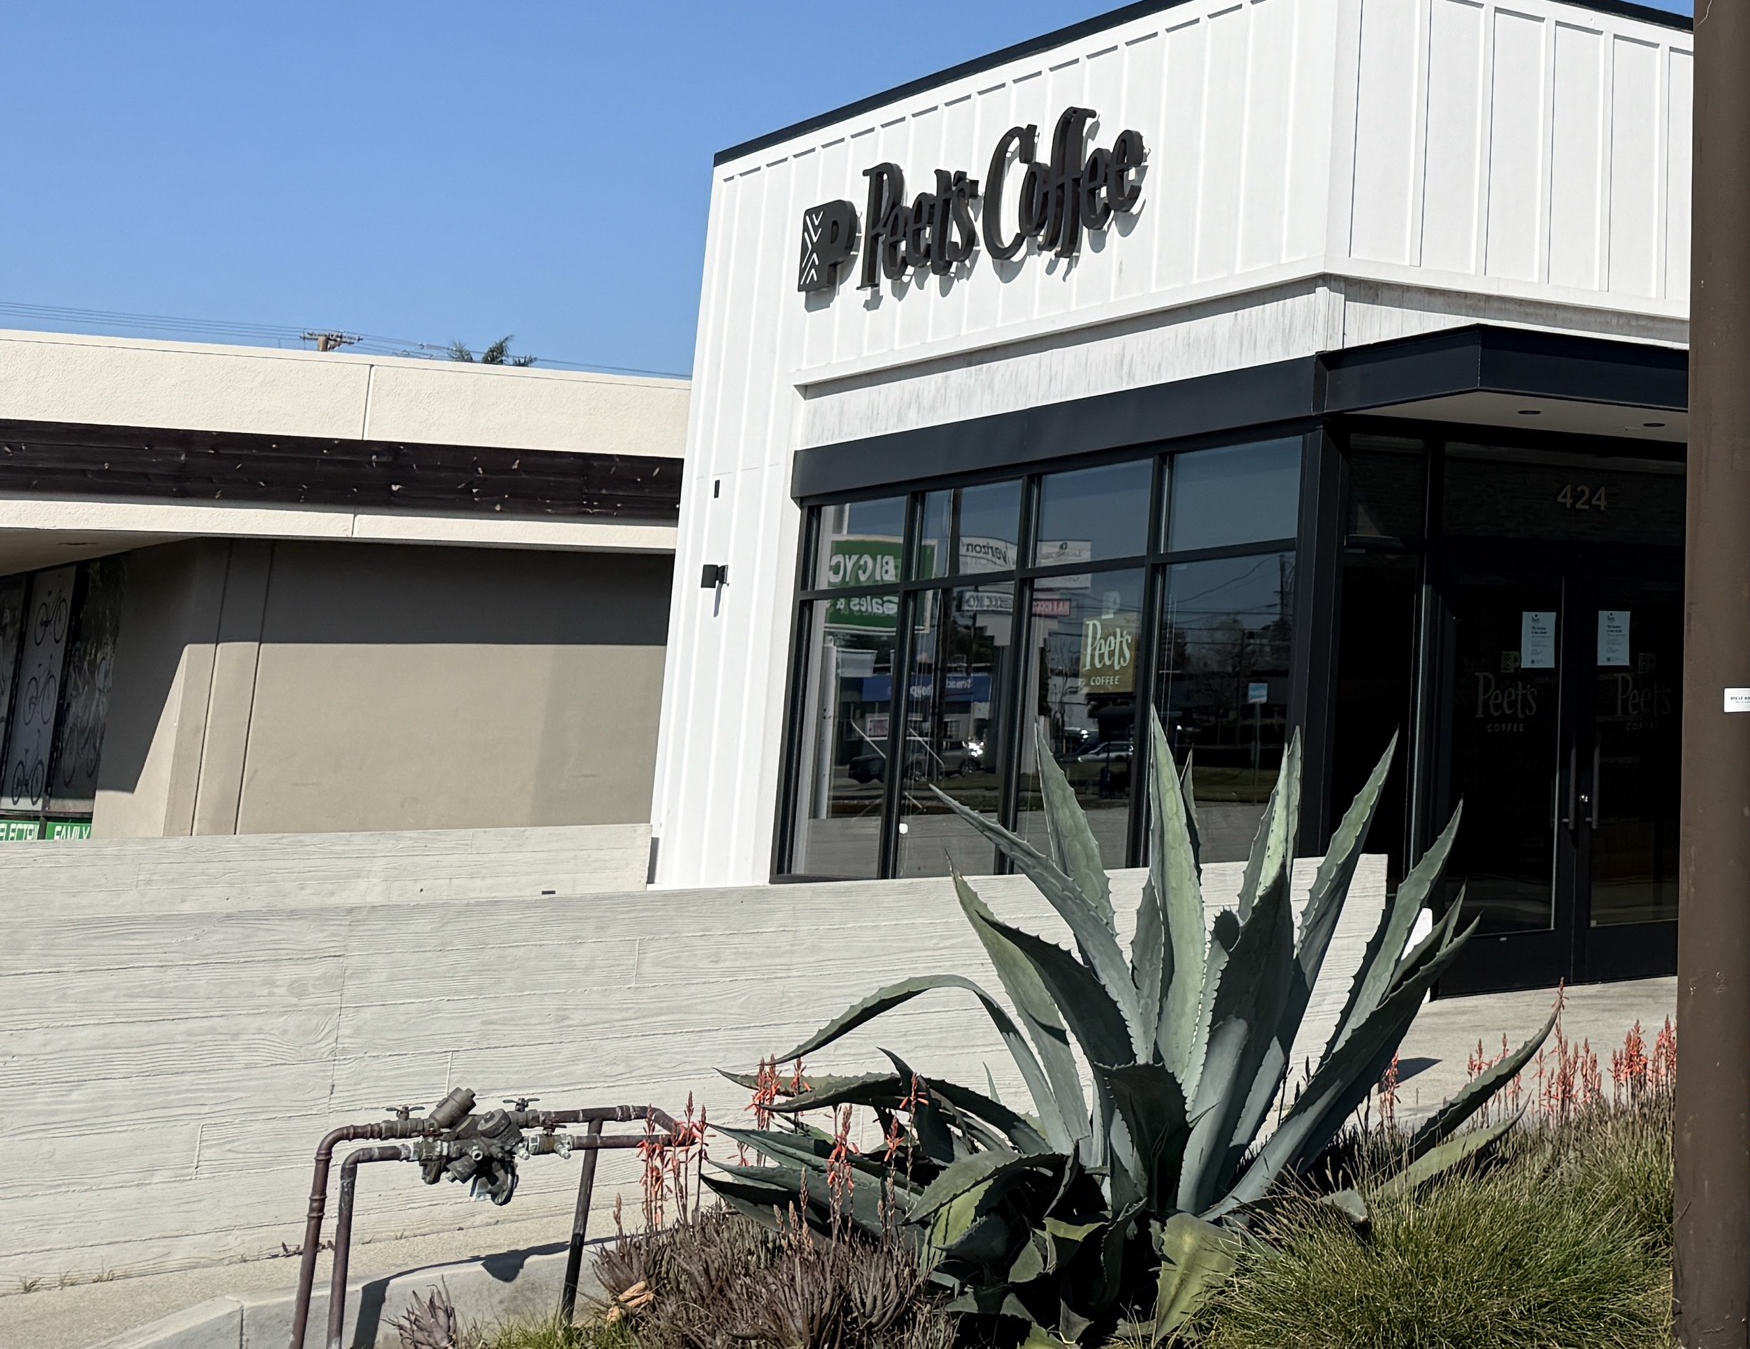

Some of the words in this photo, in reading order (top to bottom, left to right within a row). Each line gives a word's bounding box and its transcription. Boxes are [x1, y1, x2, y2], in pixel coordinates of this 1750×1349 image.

[856, 162, 979, 290] Peet's
[983, 106, 1147, 261] Coffee
[1556, 483, 1607, 511] 424
[1082, 620, 1132, 670] Peet's
[1090, 676, 1120, 685] COFFEE
[1474, 671, 1538, 719] Peet's
[1613, 672, 1672, 717] Peet's
[1486, 722, 1525, 733] COFFEE
